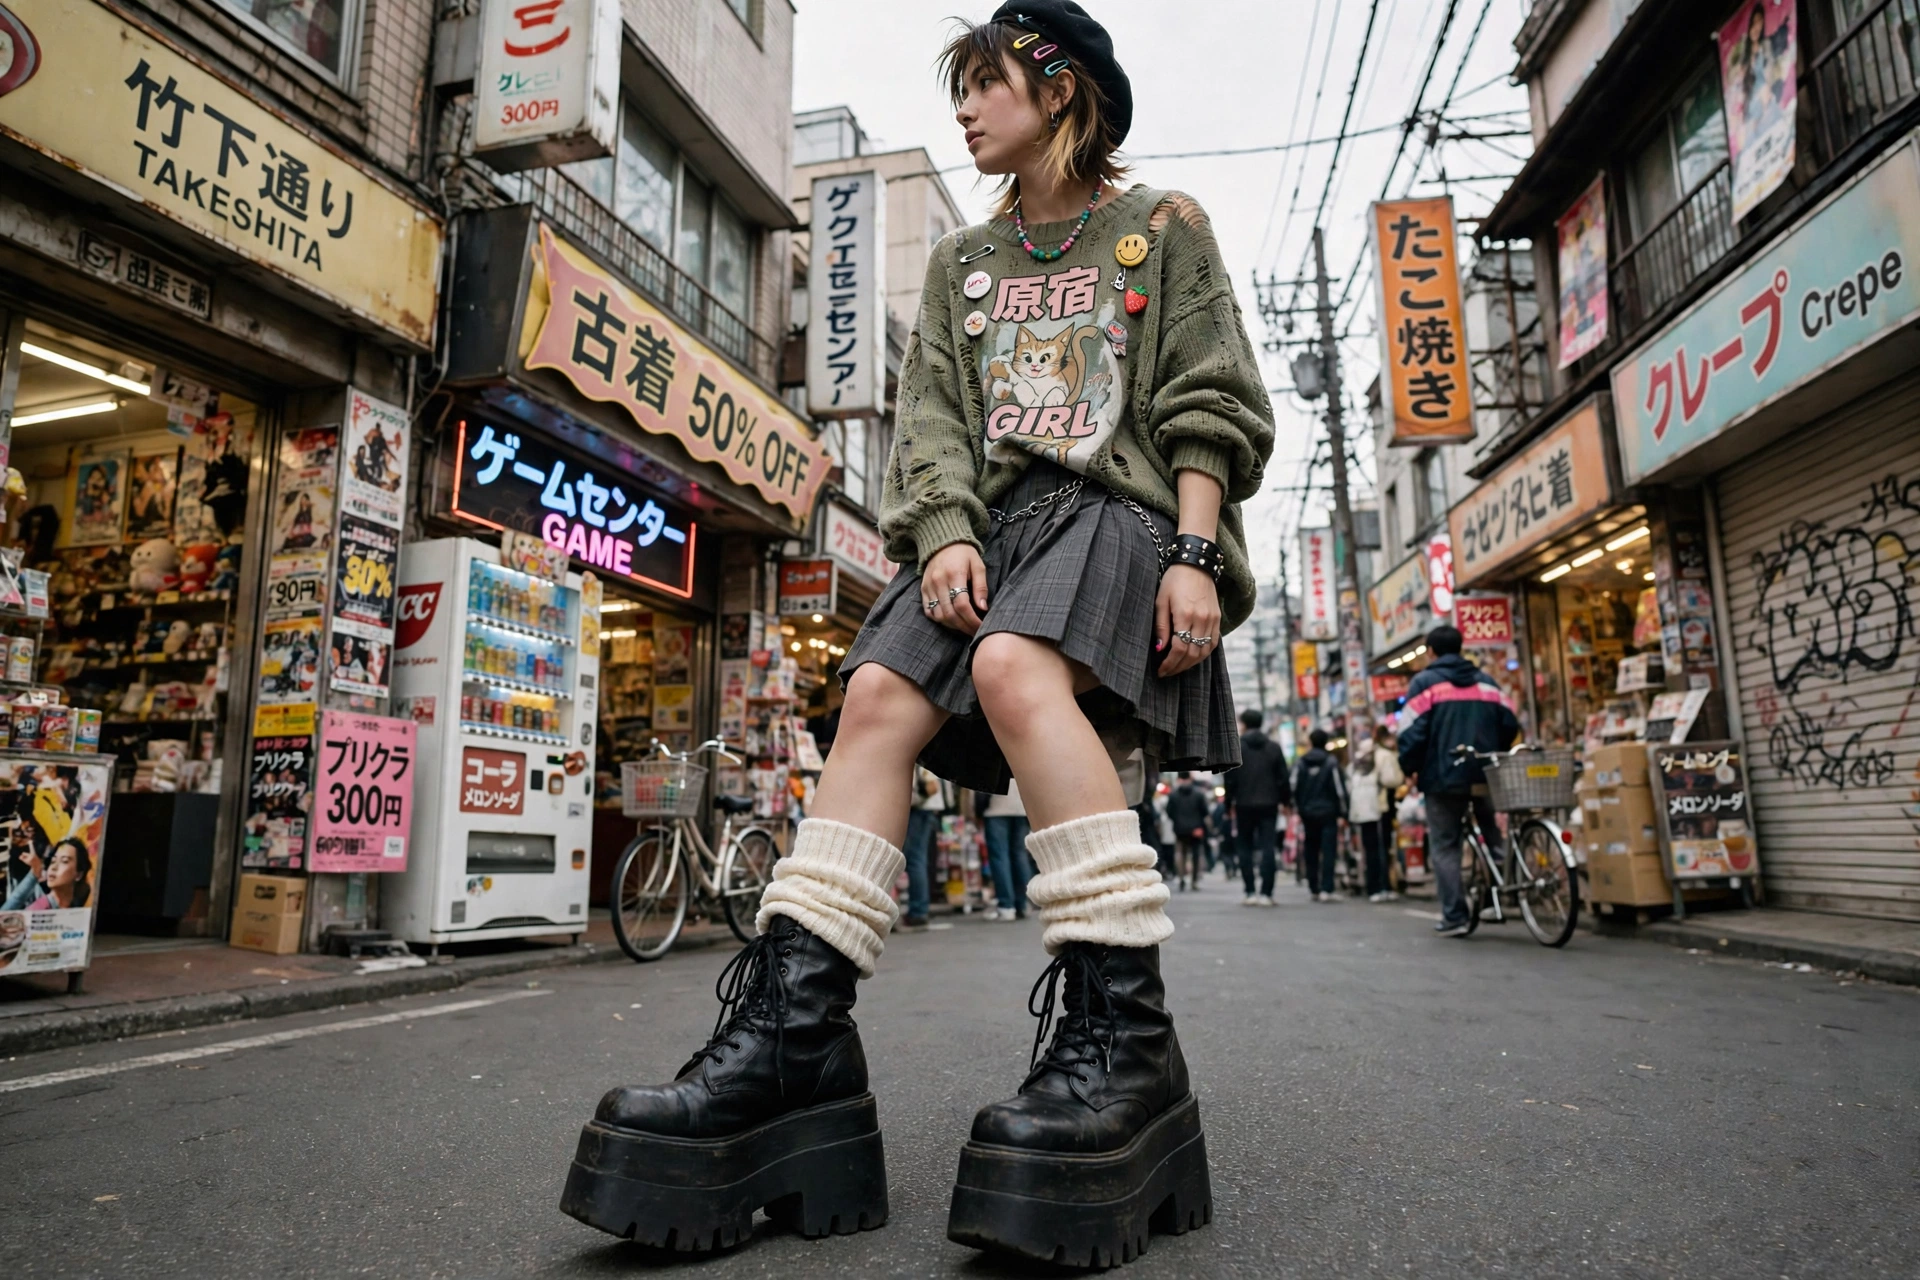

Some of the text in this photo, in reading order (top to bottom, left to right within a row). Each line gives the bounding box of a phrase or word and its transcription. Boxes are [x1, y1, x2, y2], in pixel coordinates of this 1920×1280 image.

[501, 100, 559, 124] 300円
[124, 58, 354, 239] 竹下通り
[132, 140, 323, 273] TAKESHITA
[989, 266, 1100, 323] 原宿
[1388, 213, 1456, 420] たこ焼き
[1801, 251, 1903, 338] Crepe
[1645, 269, 1788, 441] クレープ
[570, 289, 810, 497] 古着 50% OFF
[986, 400, 1099, 444] GIRL
[470, 425, 687, 547] ゲームセンター
[542, 513, 635, 576] GAME
[396, 591, 436, 622] CC
[326, 736, 410, 782] プリクラ
[466, 757, 518, 788] コーラ
[326, 782, 403, 827] 300円
[1669, 790, 1745, 815] メロンソーダ
